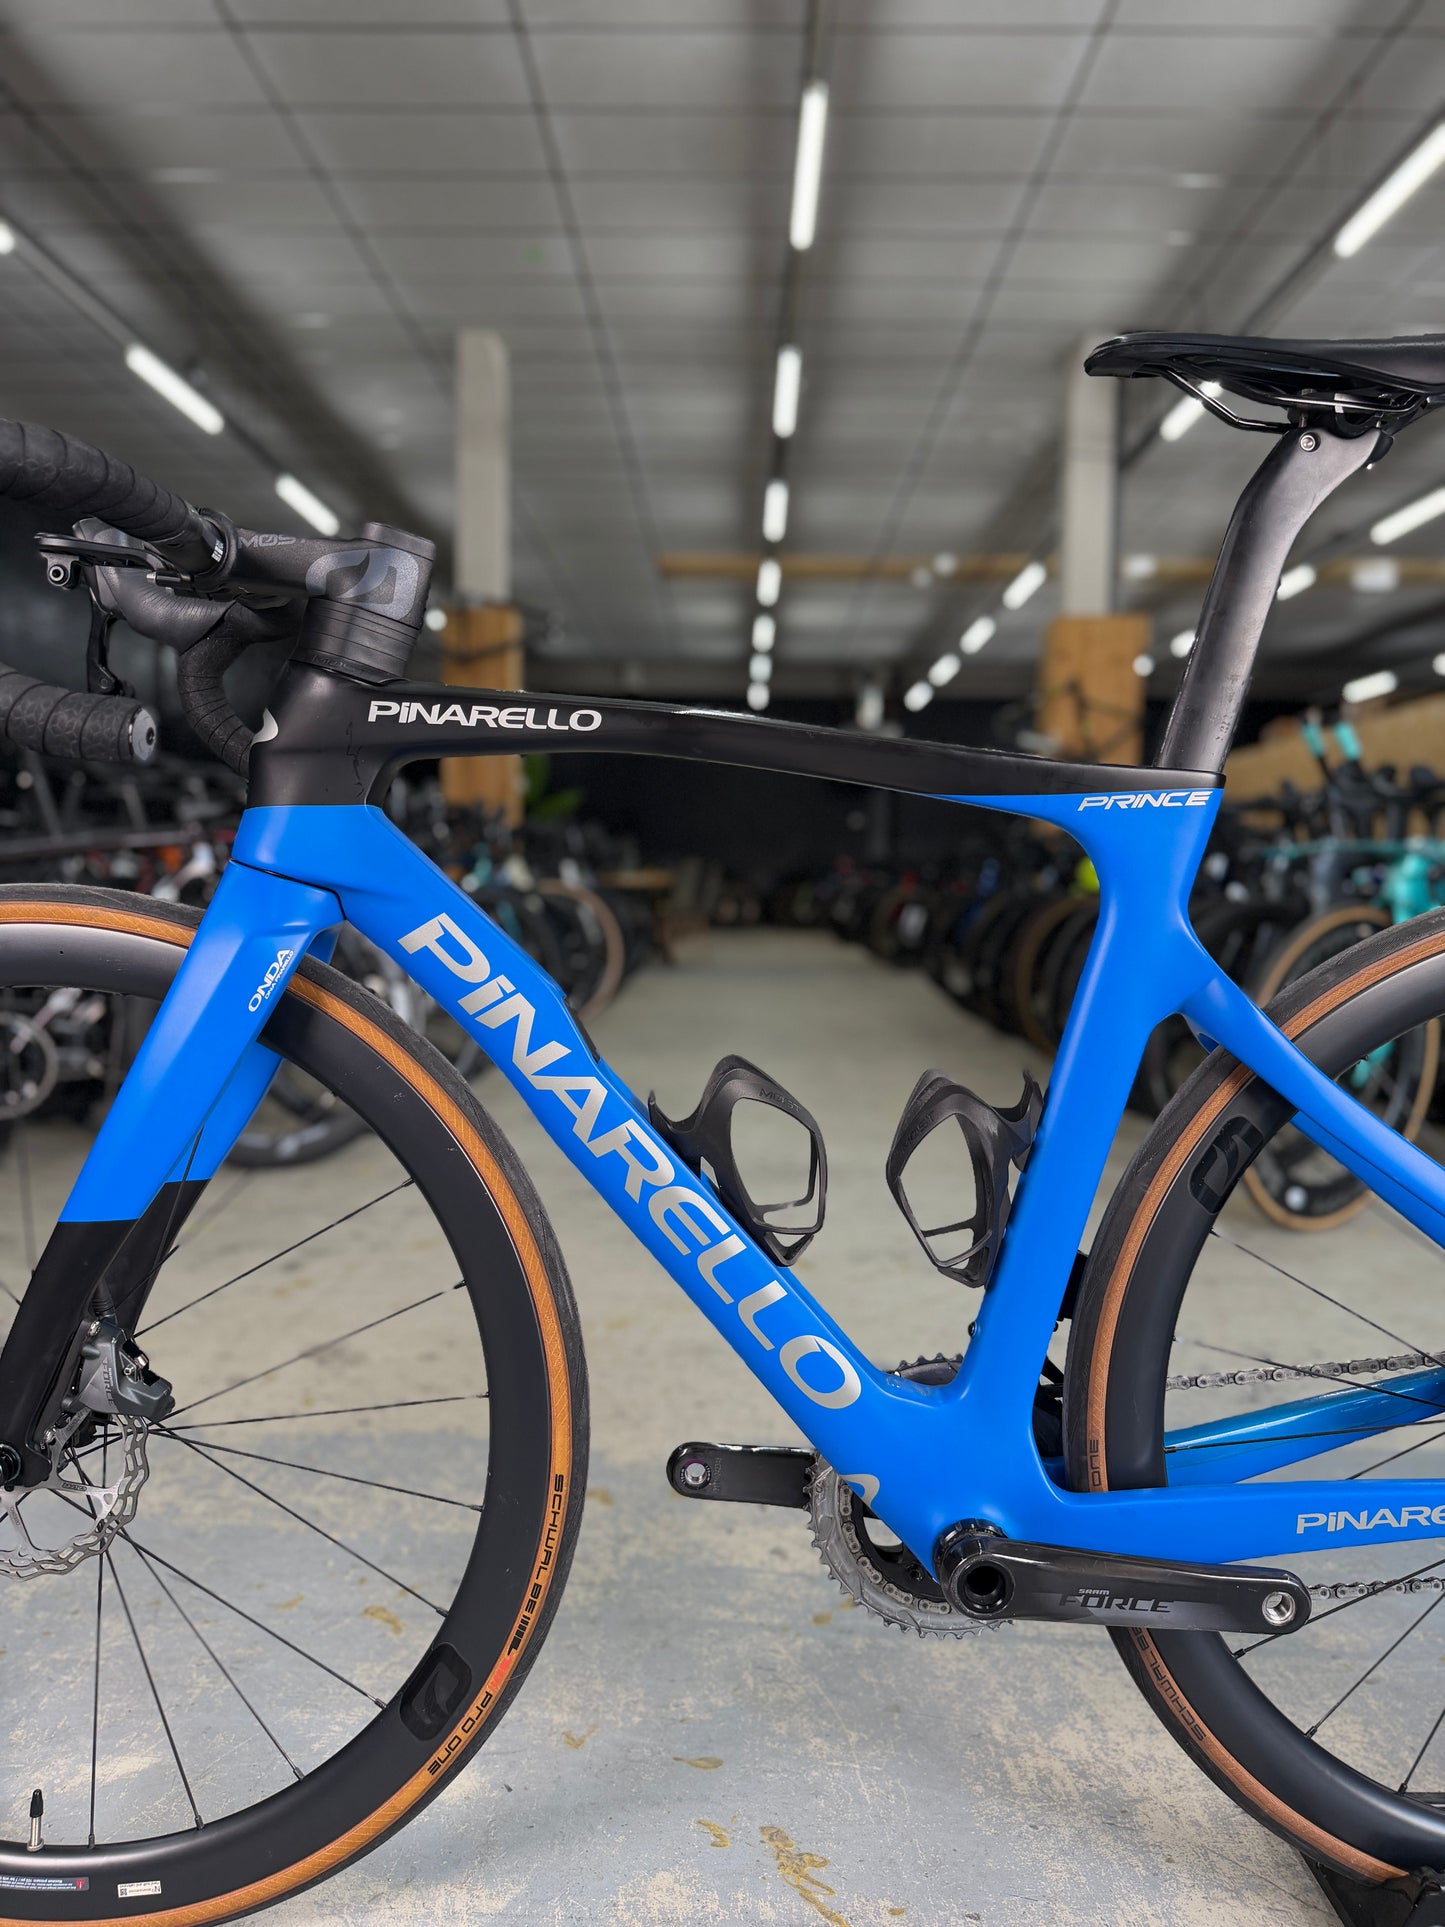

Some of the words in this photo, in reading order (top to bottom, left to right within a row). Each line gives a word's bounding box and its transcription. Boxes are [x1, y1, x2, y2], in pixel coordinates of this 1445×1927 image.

[238, 533, 305, 549] MOS
[1077, 791, 1213, 811] PRINCE
[248, 949, 291, 1012] ONDA
[1089, 1439, 1102, 1487] ONE
[525, 1473, 565, 1614] SCHWALBE
[1059, 1594, 1174, 1613] FORCE
